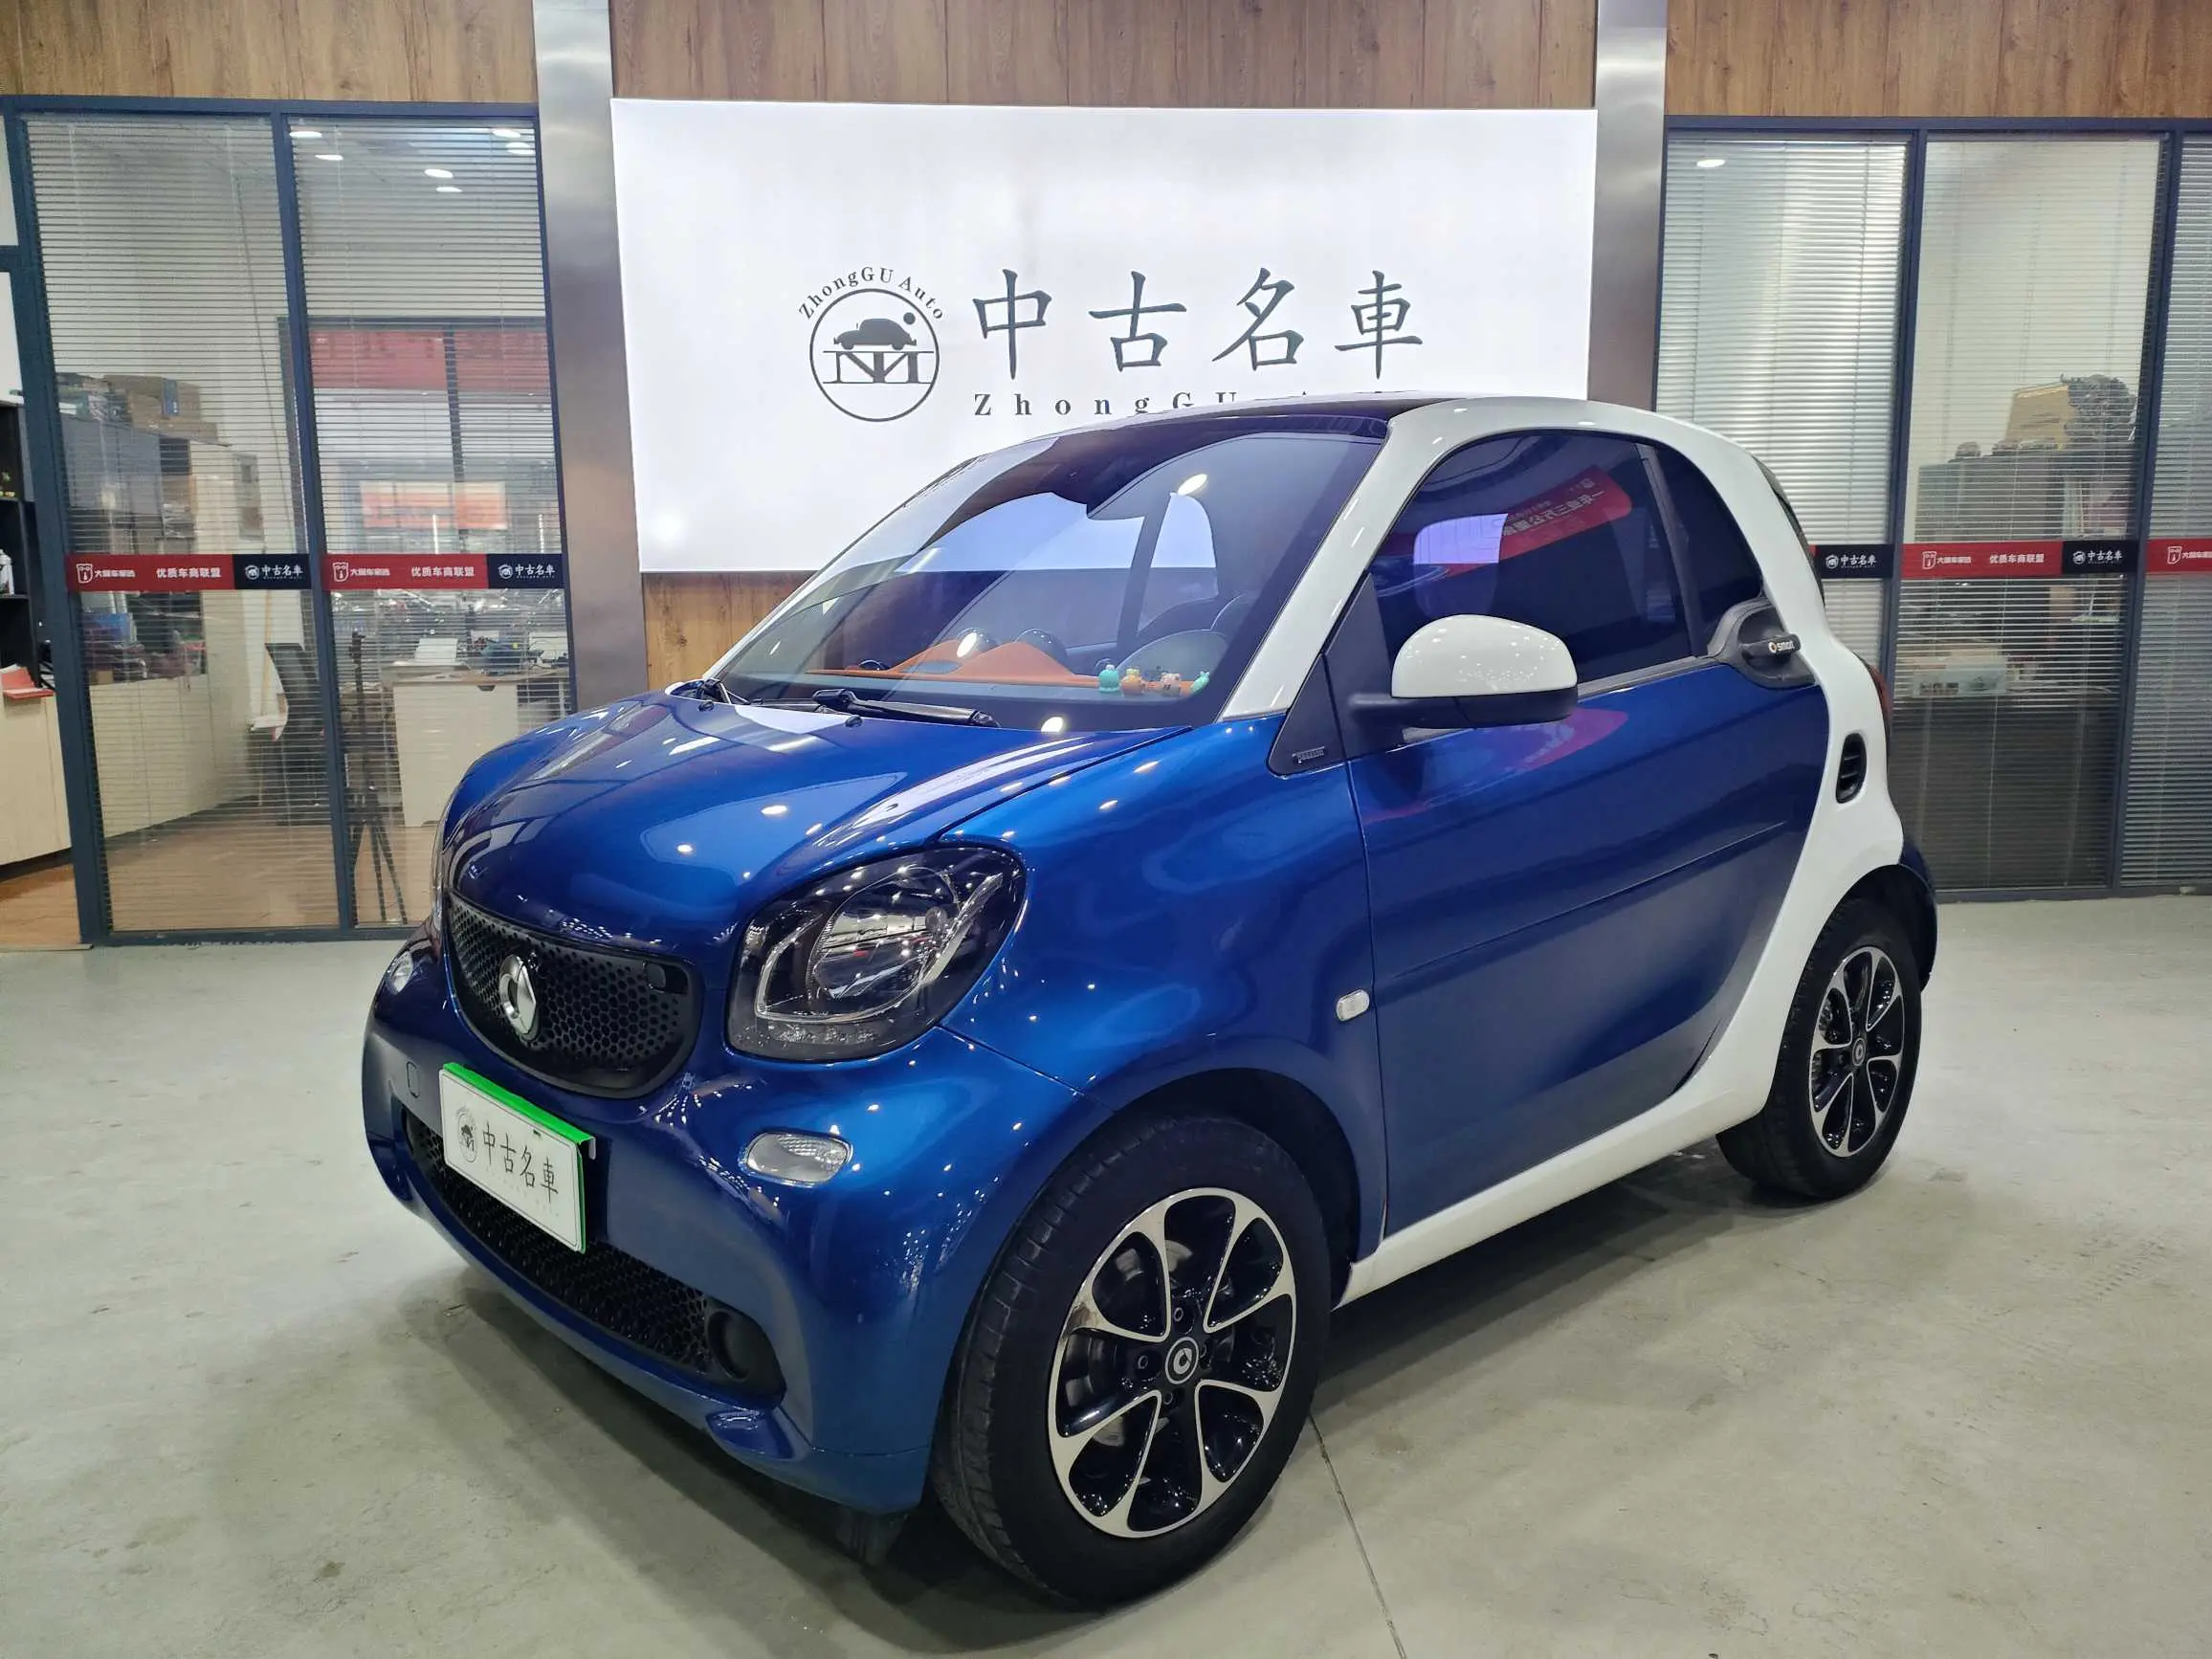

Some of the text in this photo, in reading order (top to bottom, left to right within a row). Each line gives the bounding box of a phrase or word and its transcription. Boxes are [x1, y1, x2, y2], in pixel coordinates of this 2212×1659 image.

[798, 266, 943, 320] ZhongGU Auto
[972, 267, 1424, 380] 中古名車
[156, 567, 221, 579] 优质车商联盟
[410, 566, 476, 578] 优质车商联盟
[1989, 553, 2045, 564] 优质车商联盟
[481, 1120, 559, 1203] 中古名車
